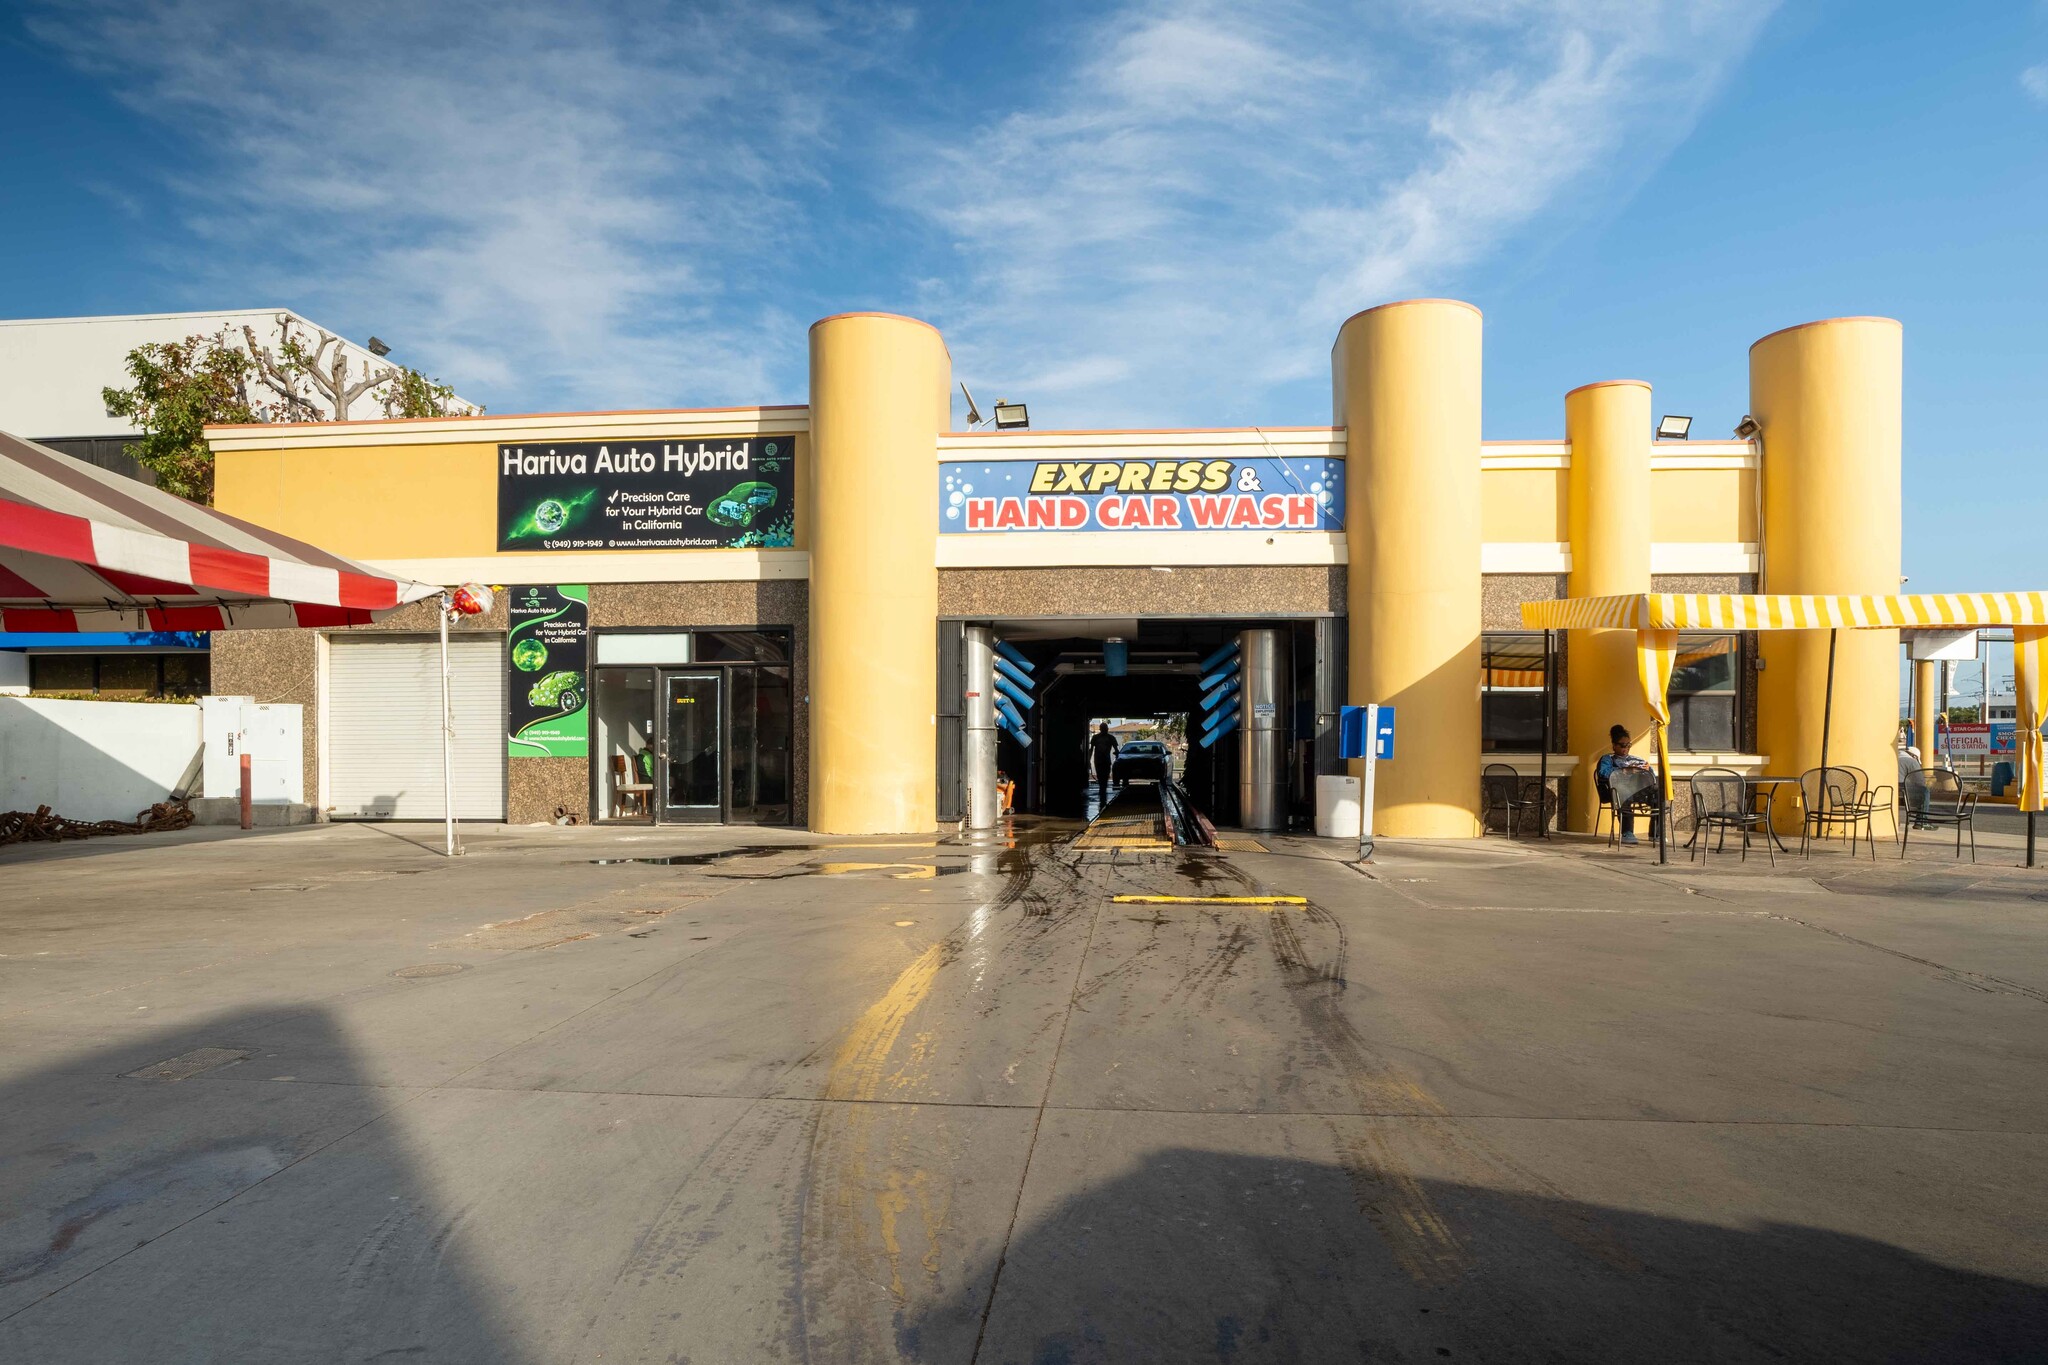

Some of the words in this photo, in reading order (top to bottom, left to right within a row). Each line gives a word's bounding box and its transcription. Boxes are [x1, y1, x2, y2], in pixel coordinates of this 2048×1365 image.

[503, 446, 587, 476] Hariva
[594, 445, 656, 475] Auto
[663, 442, 749, 478] Hybrid
[1028, 461, 1236, 495] EXPRESS
[1237, 466, 1264, 493] &
[621, 491, 664, 503] Precision
[666, 491, 690, 502] Care
[605, 506, 620, 517] for
[621, 505, 647, 517] Your
[648, 504, 683, 518] Hybrid
[685, 504, 703, 516] Car
[966, 496, 1089, 530] HAND
[1096, 496, 1180, 530] CAR
[1190, 495, 1315, 528] WASH
[622, 520, 633, 530] in
[634, 519, 682, 530] California
[552, 540, 571, 549] (949)
[572, 540, 603, 548] 919-1949
[616, 538, 717, 548] www.harivaautohybrid.com
[558, 629, 576, 637] Hybrid
